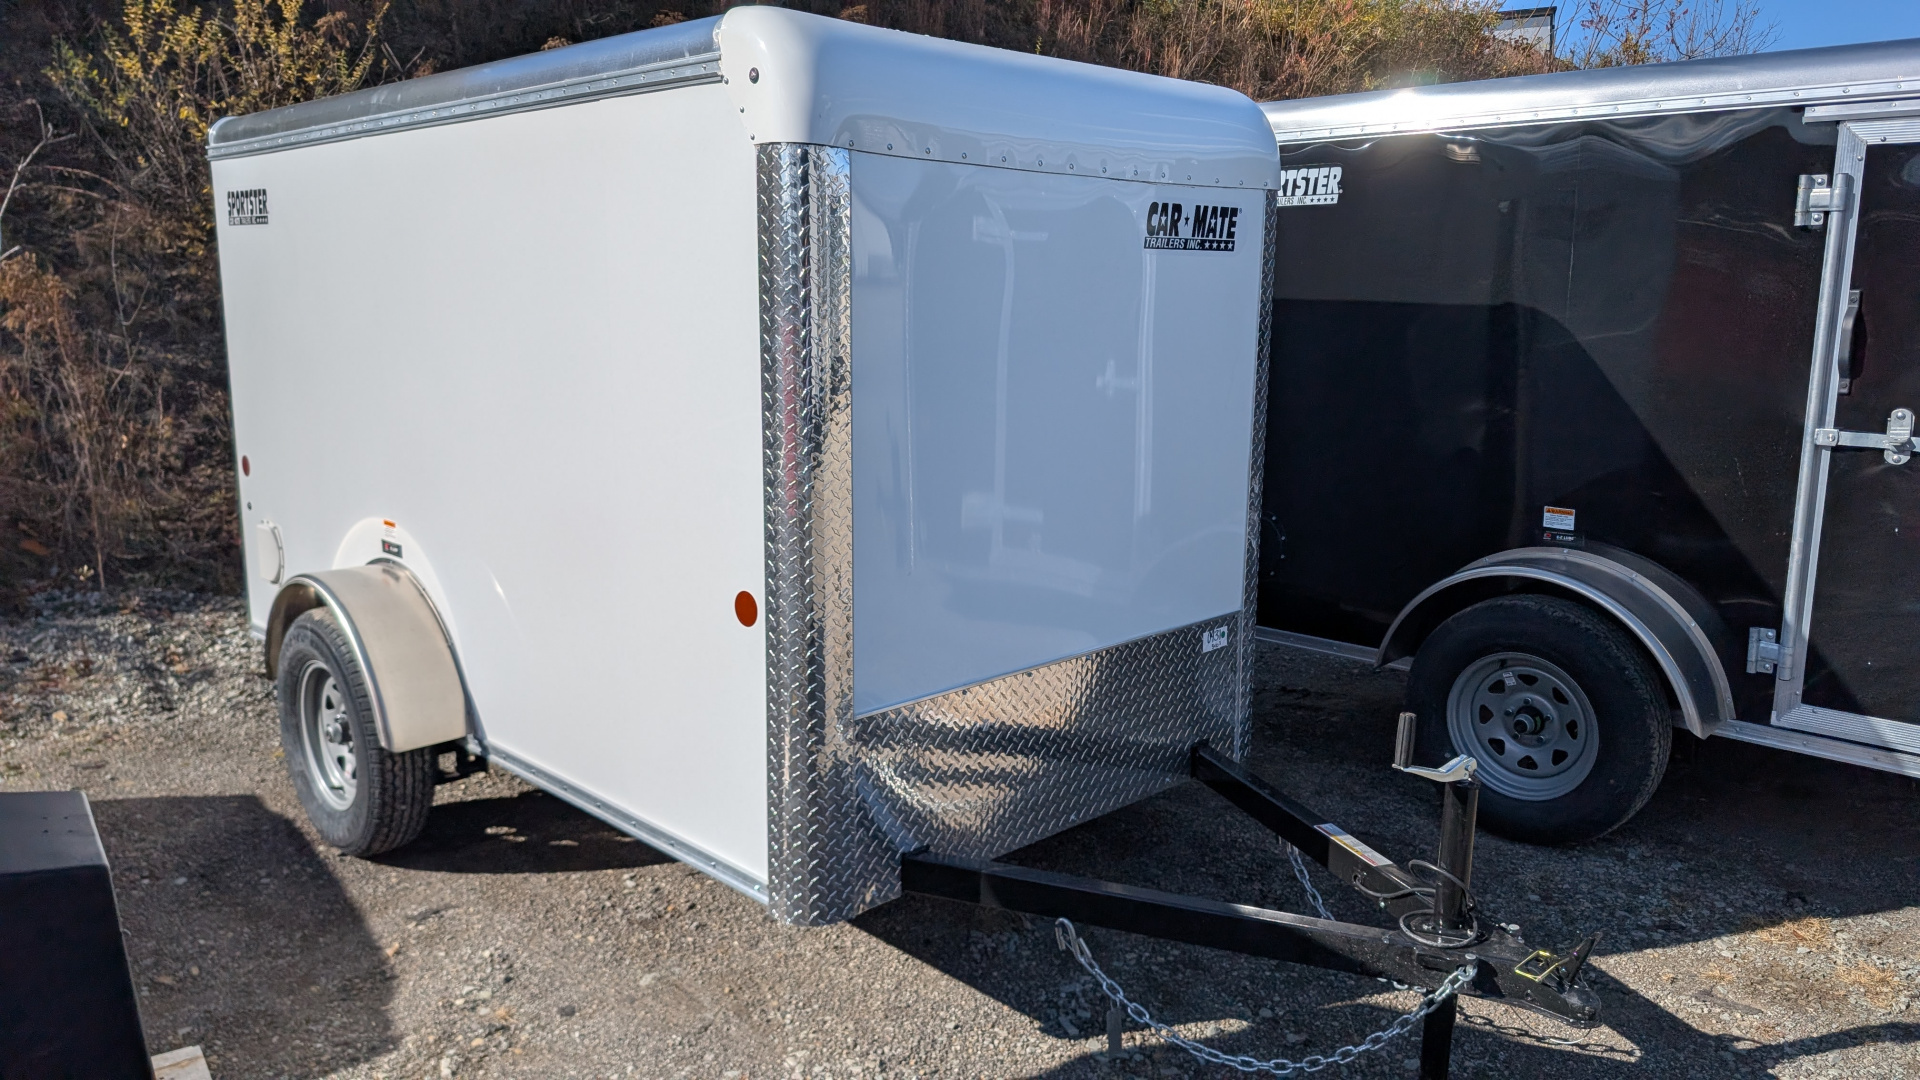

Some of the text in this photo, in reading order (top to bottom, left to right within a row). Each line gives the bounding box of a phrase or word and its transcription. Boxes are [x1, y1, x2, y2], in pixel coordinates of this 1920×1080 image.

[227, 188, 268, 216] SPORTSTER
[1146, 201, 1239, 239] CAR MATE
[1145, 238, 1203, 250] TRAILERS INC.
